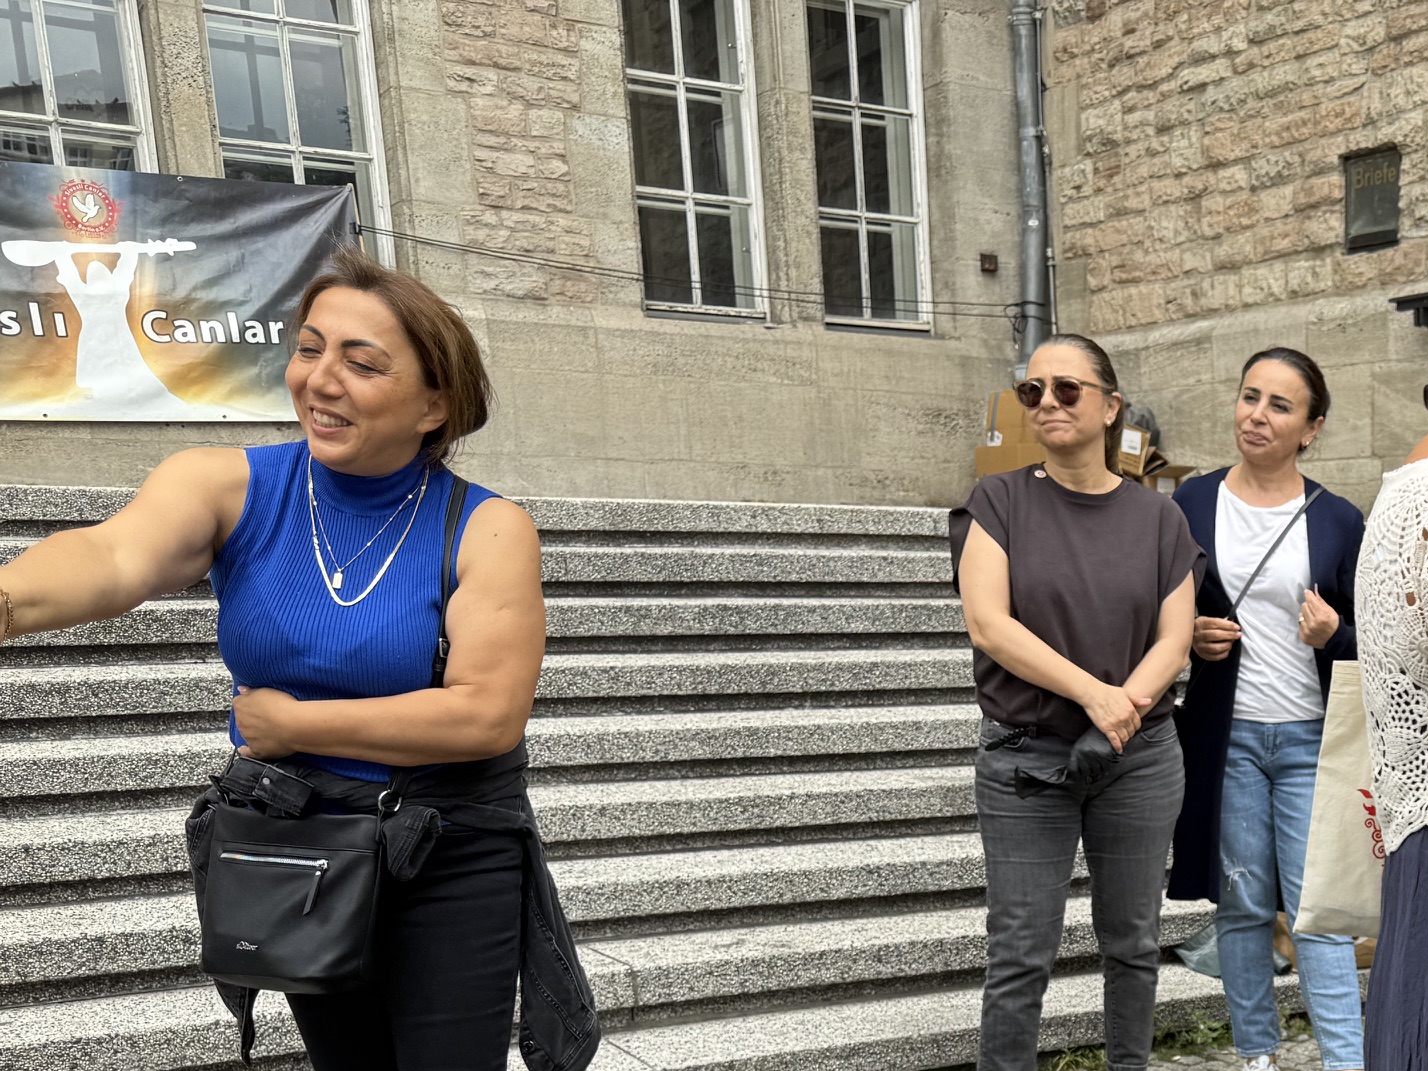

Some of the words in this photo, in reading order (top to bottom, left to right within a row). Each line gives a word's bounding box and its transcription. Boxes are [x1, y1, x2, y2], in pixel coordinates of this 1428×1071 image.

[1353, 161, 1396, 189] Briefe
[84, 184, 106, 199] Canlar
[141, 309, 284, 344] Canlar
